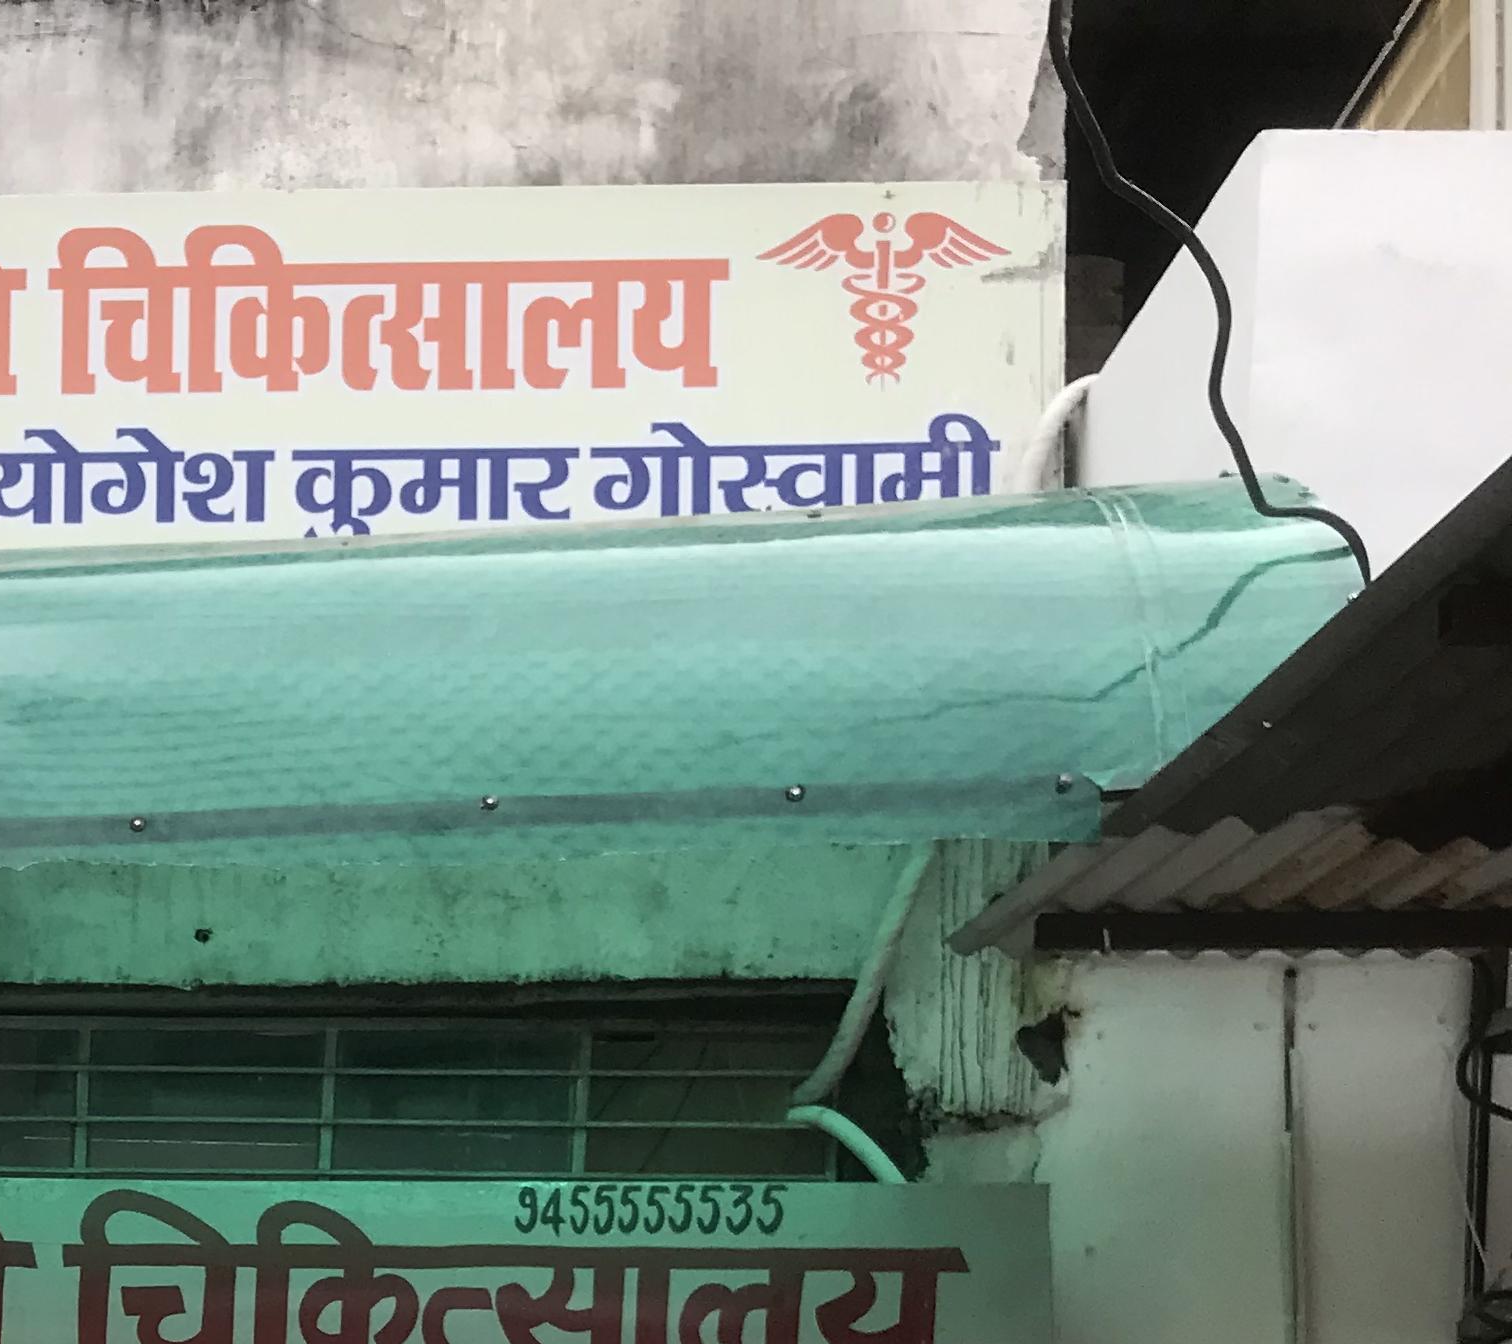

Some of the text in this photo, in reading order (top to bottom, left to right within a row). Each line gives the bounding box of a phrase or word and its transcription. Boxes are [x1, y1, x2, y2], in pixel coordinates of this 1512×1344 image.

[48, 225, 730, 395] चिकित्सालय
[291, 447, 581, 539] कुमार
[589, 413, 1001, 517] गोस्वामी
[514, 1184, 788, 1237] 9455555535
